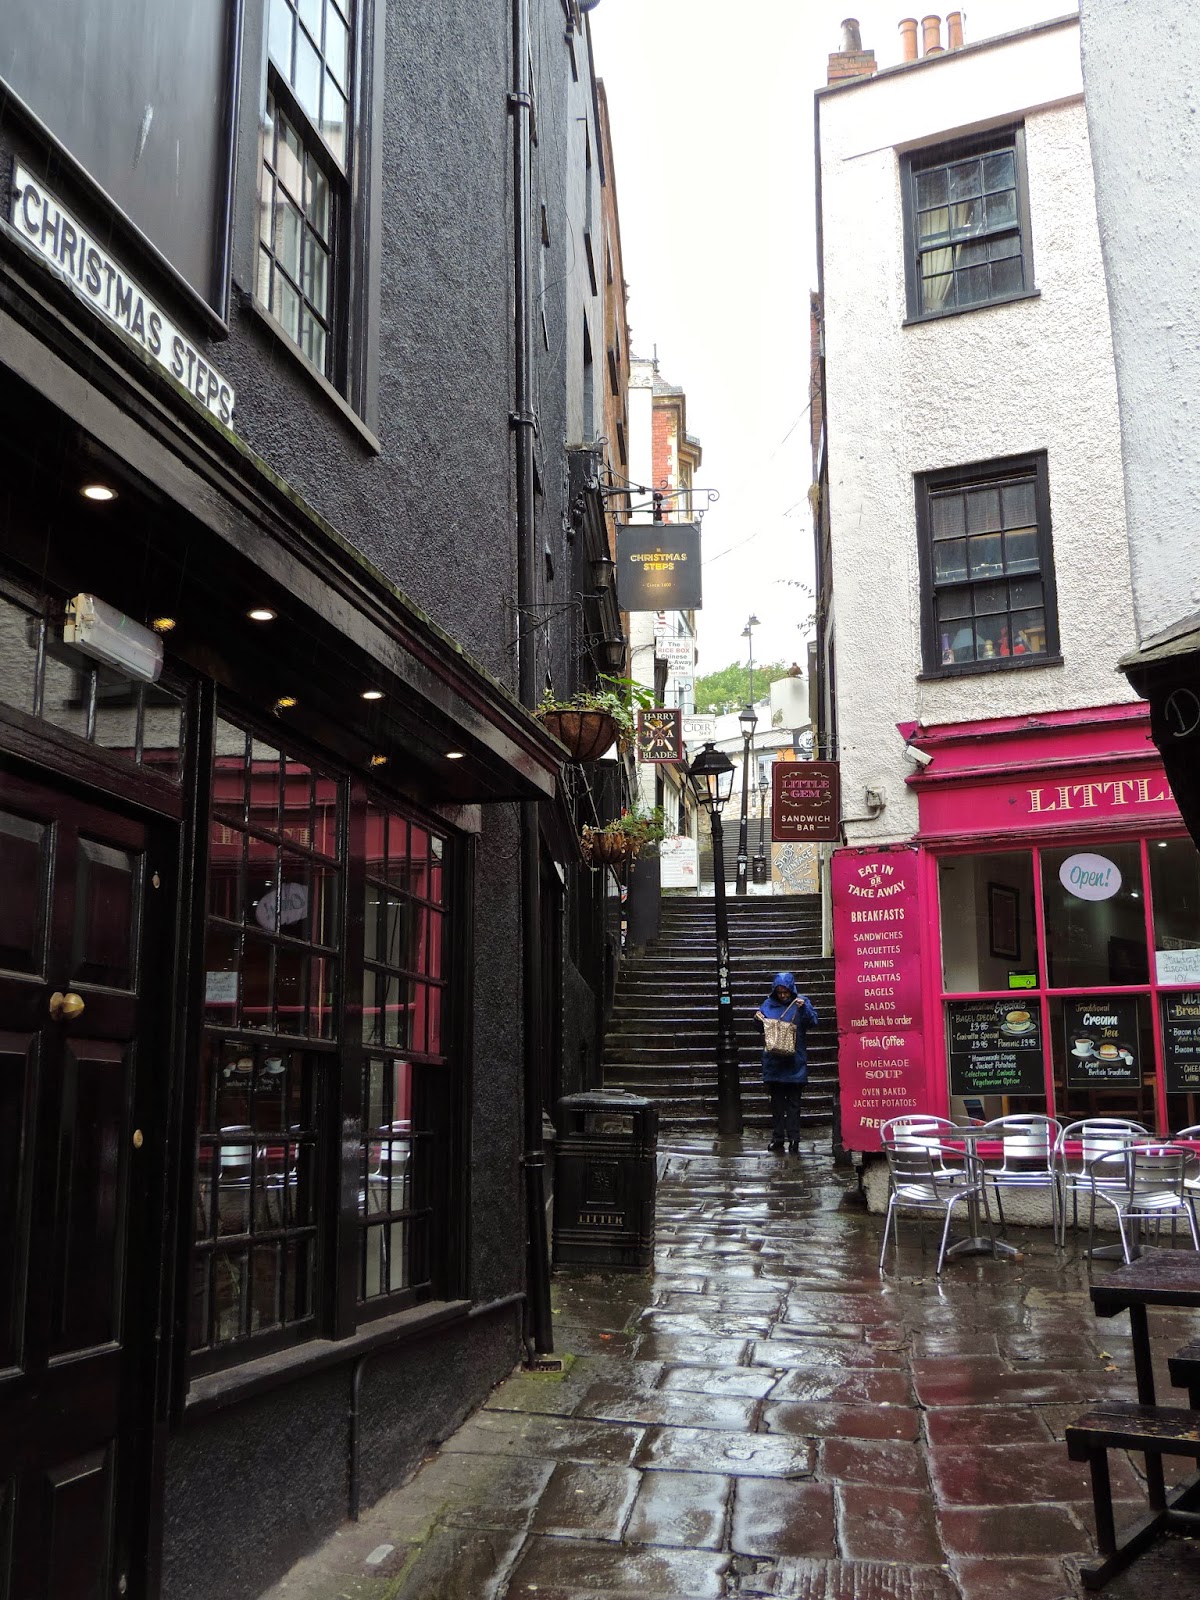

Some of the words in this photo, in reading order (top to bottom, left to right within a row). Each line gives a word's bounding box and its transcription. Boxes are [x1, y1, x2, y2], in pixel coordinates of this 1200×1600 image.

[23, 184, 162, 356] CHRISTMAS
[171, 335, 231, 424] STEPS
[630, 553, 687, 562] CHRISTMAS
[643, 562, 674, 571] STEPS
[643, 713, 675, 721] HARRY
[657, 739, 664, 747] D
[782, 780, 830, 789] LITTLE
[790, 790, 820, 798] GEM
[774, 843, 795, 869] SHOP
[784, 848, 813, 874] VINTAGE
[858, 864, 878, 877] EAT
[881, 864, 894, 875] IN
[870, 876, 881, 885] OR
[1070, 866, 1111, 889] Open!
[848, 884, 875, 898] TAKE
[877, 880, 905, 898] AWAY
[851, 908, 904, 922] BREAKFASTS
[854, 931, 903, 942] SANDWICHES
[857, 945, 900, 955] BAGUETTES
[864, 960, 894, 968] PANINIS
[1164, 962, 1199, 973] discount
[857, 973, 900, 983] CIABATTAS
[865, 988, 894, 997] BAGELS
[865, 1002, 895, 1010] SALADS
[994, 1001, 1026, 1015] Specials
[851, 1018, 868, 1027] made
[869, 1016, 886, 1026] fresh
[887, 1016, 893, 1025] to
[895, 1015, 912, 1025] order
[956, 1014, 975, 1023] BAGEL
[976, 1014, 999, 1022] SPECIAL
[1083, 1013, 1118, 1025] Cream
[1101, 1026, 1119, 1038] Tea
[1173, 1028, 1191, 1036] Bacon
[860, 1036, 880, 1049] Fresh
[882, 1035, 904, 1050] Coffee
[1174, 1045, 1193, 1054] Bacon
[857, 1059, 909, 1068] HOMEMADE
[1085, 1061, 1100, 1069] Great
[866, 1070, 902, 1079] SOUP
[1088, 1068, 1106, 1076] British
[1107, 1068, 1131, 1076] Tradition
[862, 1088, 880, 1096] OVEN
[883, 1087, 906, 1095] BAKED
[853, 1099, 879, 1108] JACKET
[882, 1098, 917, 1107] POTATOES
[859, 1116, 885, 1129] FREE
[578, 1215, 622, 1224] LITTER
